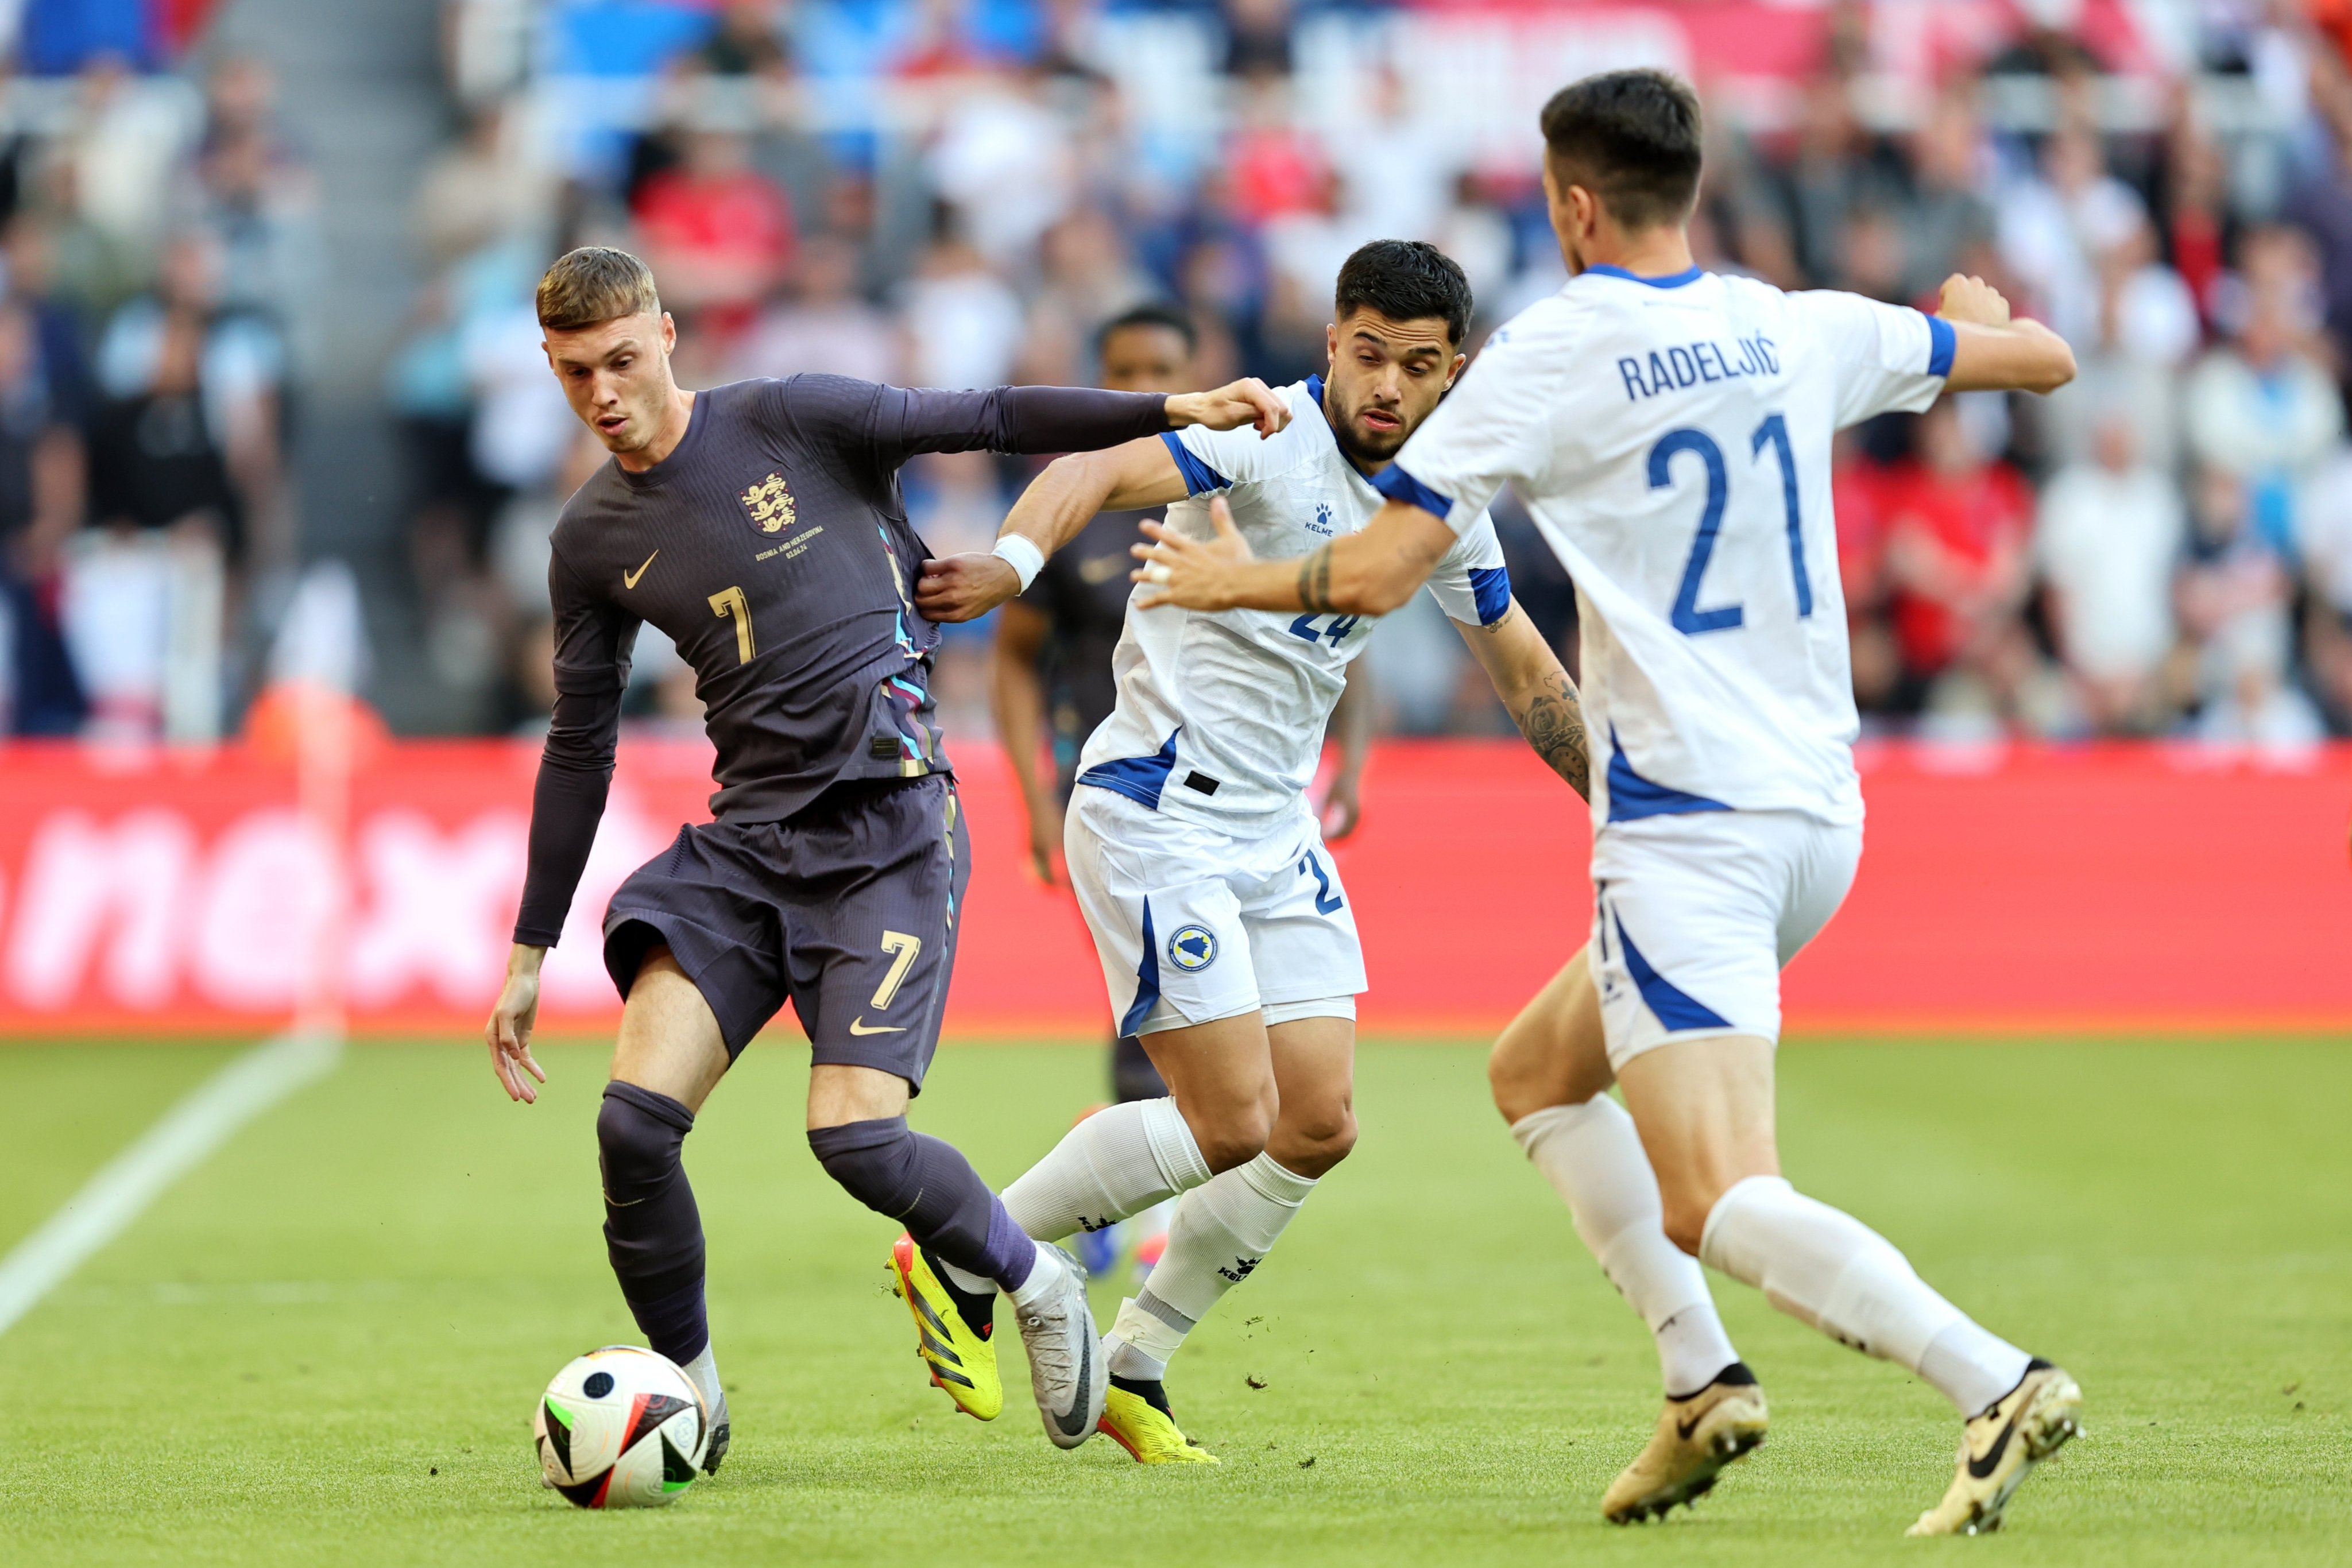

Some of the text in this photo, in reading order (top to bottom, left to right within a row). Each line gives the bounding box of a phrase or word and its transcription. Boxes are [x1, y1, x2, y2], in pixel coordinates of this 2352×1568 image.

[1618, 328, 1779, 401] RADELJIĆ
[755, 525, 824, 562] BOSNIA AND HERZEGOVINA
[785, 543, 808, 559] 03.06.24
[1304, 521, 1333, 537] KELME
[1647, 413, 1813, 636] 21
[707, 586, 756, 665] 7
[870, 930, 922, 1011] 7
